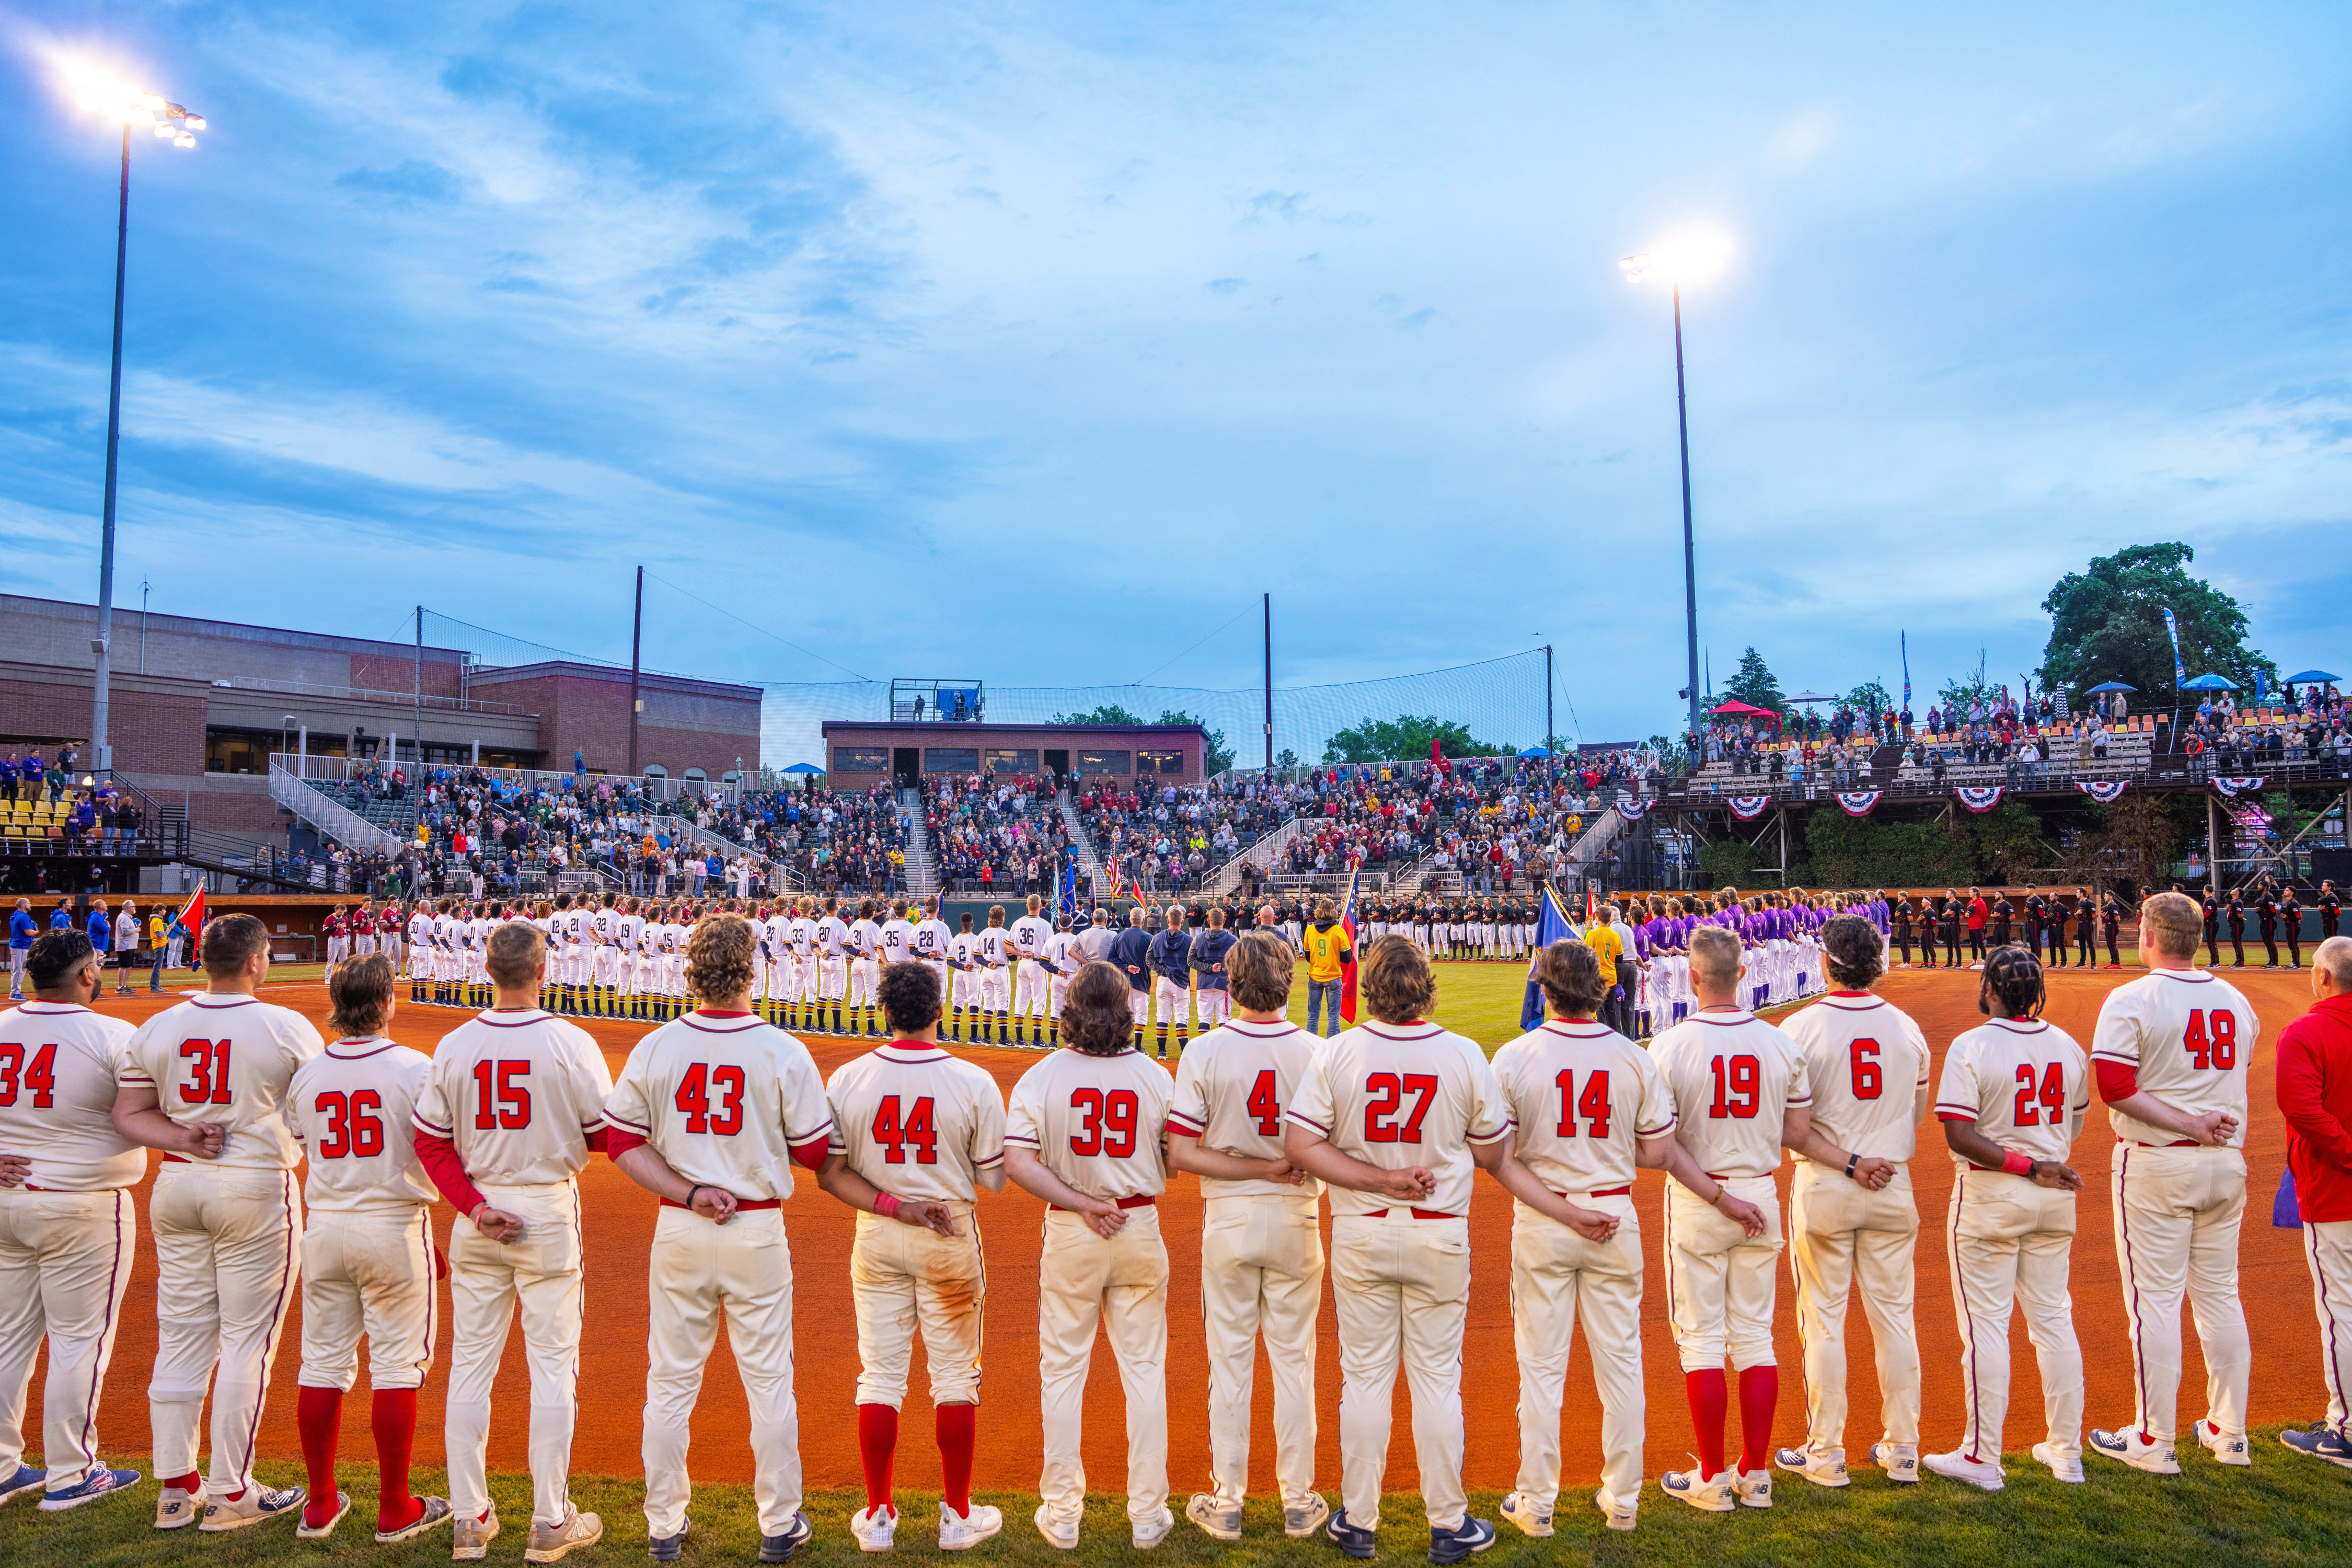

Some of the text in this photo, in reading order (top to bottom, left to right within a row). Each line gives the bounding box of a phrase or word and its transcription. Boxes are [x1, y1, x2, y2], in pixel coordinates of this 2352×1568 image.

[411, 921, 419, 934] 30
[434, 921, 441, 935] 18
[552, 920, 559, 934] 12
[571, 918, 579, 932] 21
[596, 918, 606, 932] 32
[1739, 913, 1745, 928] 31
[448, 927, 453, 940] 4
[470, 927, 476, 939] 11
[621, 924, 630, 938] 19
[645, 930, 651, 944] 5
[766, 926, 775, 941] 22
[792, 928, 803, 944] 33
[818, 926, 830, 942] 20
[854, 929, 862, 946] 31
[885, 930, 899, 947] 35
[919, 930, 933, 947] 28
[1019, 927, 1034, 946] 36
[1665, 926, 1670, 943] 17
[664, 933, 672, 947] 15
[984, 937, 995, 954] 14
[1318, 938, 1327, 957] 9
[1644, 935, 1649, 952] 0
[959, 945, 966, 962] 2
[1060, 943, 1065, 960] 1
[1605, 943, 1611, 960] 6
[2184, 1009, 2236, 1070] 48
[0, 1043, 57, 1108] 34
[179, 1039, 232, 1104] 31
[1850, 1037, 1883, 1100] 6
[474, 1060, 531, 1129] 15
[1710, 1055, 1760, 1119] 19
[2014, 1062, 2066, 1126] 24
[674, 1062, 745, 1136] 43
[1247, 1070, 1280, 1136] 4
[1556, 1069, 1611, 1138] 14
[1365, 1073, 1438, 1144] 27
[315, 1089, 384, 1158] 36
[871, 1094, 937, 1164] 44
[1070, 1088, 1138, 1158] 39
